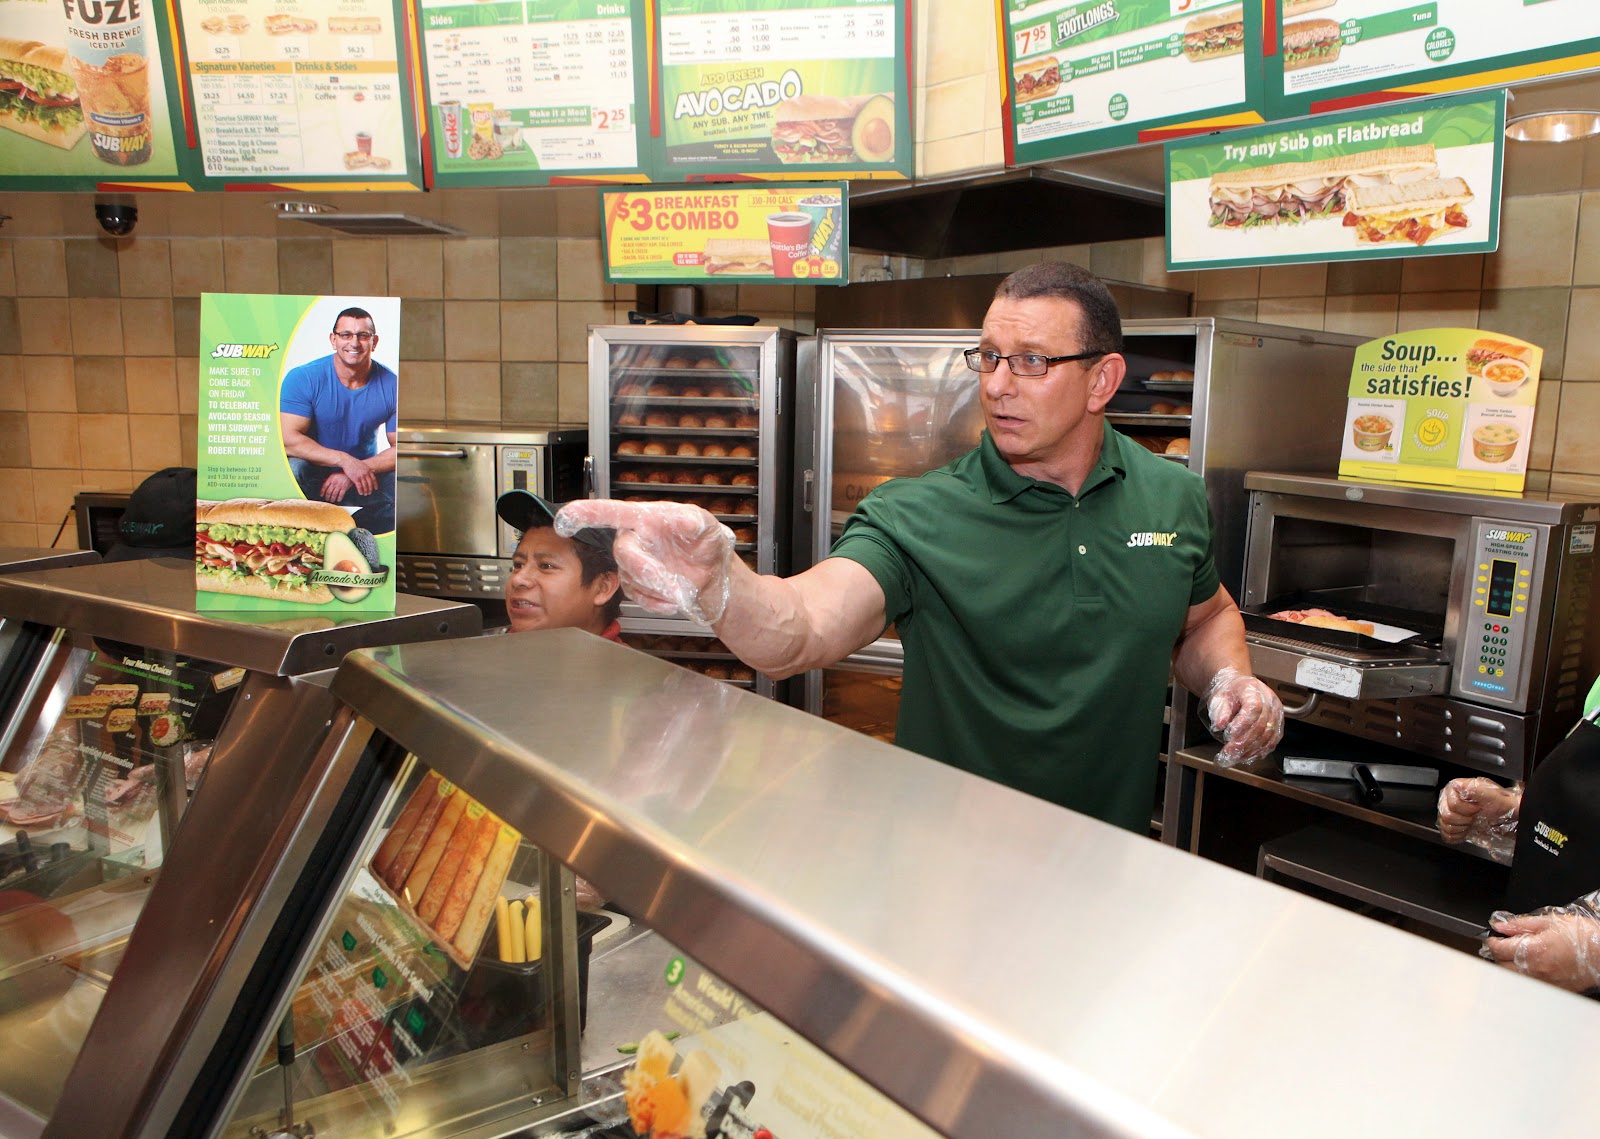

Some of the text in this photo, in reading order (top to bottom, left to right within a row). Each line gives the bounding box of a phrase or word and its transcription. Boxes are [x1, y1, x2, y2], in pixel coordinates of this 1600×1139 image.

[62, 0, 141, 25] FUZE
[597, 4, 625, 15] Drinks
[430, 15, 453, 25] Sides
[1057, 2, 1114, 40] FOOTLONGS
[1412, 12, 1432, 22] Tuna
[1346, 20, 1356, 28] 470
[68, 26, 142, 41] FRESH BREWED
[1119, 48, 1138, 58] Turkey
[1144, 42, 1163, 51] Bacon
[1119, 54, 1144, 65] Avocado
[195, 62, 276, 73] Signature Varieties
[294, 62, 358, 71] Drinks & Sides
[701, 67, 765, 86] ADD FRESH
[673, 69, 803, 120] AVOCADO
[529, 109, 551, 118] Make
[552, 109, 559, 117] it
[567, 108, 587, 117] Meal
[1038, 104, 1071, 117] Cheesesteak
[693, 111, 774, 129] ANY SUB. ANY TIME.
[446, 113, 460, 154] Coke
[1222, 117, 1423, 162] Try any Sub on Flatbread
[93, 131, 149, 152] SUBWAY
[654, 195, 739, 209] BREAKFAST
[616, 198, 654, 231] $3
[655, 210, 739, 231] COMBO
[795, 242, 808, 251] Best
[211, 343, 279, 360] SUBWAY
[1381, 339, 1458, 366] Soup...
[209, 367, 261, 376] MAKE SURE TO
[1361, 362, 1418, 374] the side that
[208, 378, 251, 387] COME BACK
[1366, 375, 1473, 398] satisfies!
[209, 389, 246, 398] ON FRIDAY
[208, 401, 260, 410] TO CELEBRATE
[208, 412, 271, 421] AVOCADO SEASON
[1426, 408, 1449, 420] SOUP
[207, 423, 227, 432] WITH
[264, 424, 270, 433] &
[208, 434, 268, 444] CELEBRITY CHEF
[207, 446, 265, 456] ROBERT IRVINE!
[1126, 532, 1178, 548] SUBWAY
[1486, 529, 1532, 543] SUBWAY
[1485, 547, 1512, 556] TOASTING
[1490, 542, 1524, 551] HIGH-SPEED
[310, 572, 385, 585] Avocado Season
[122, 656, 137, 667] Your
[134, 659, 152, 671] Menu
[150, 663, 173, 676] Choices
[1534, 820, 1569, 849] SUBWAY
[667, 959, 683, 983] 3
